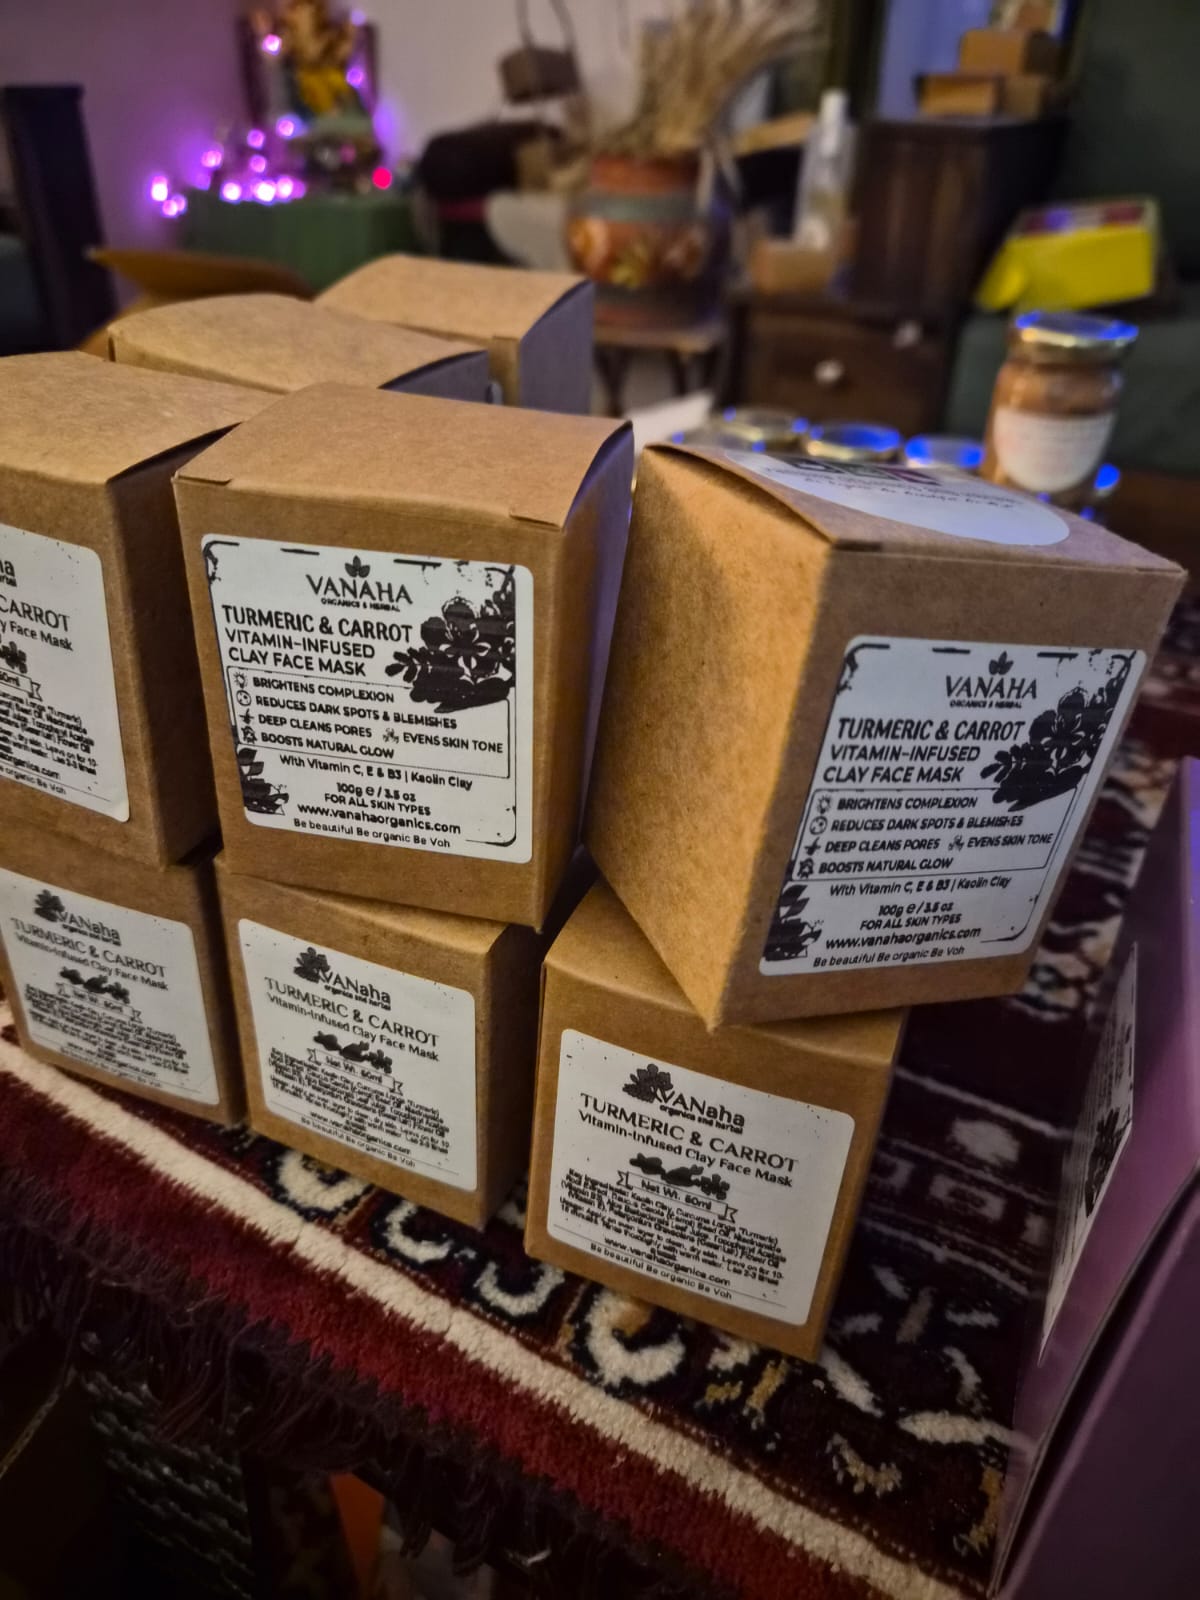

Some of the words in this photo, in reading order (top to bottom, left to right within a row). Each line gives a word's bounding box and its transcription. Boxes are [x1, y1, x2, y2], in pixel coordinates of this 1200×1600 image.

[305, 574, 413, 605] VANAHA
[9, 620, 37, 639] Face
[40, 630, 73, 651] Mask
[221, 604, 314, 633] TURMERIC
[319, 616, 334, 635] &
[338, 618, 413, 643] CARROT
[225, 627, 375, 659] VITAMIN-INFUSED
[228, 646, 268, 665] CLAY
[273, 652, 314, 671] FACE
[318, 657, 366, 677] MASK
[253, 677, 315, 694] BRIGHTENS
[318, 685, 394, 703] COMPLEXION
[946, 675, 1037, 700] VANAHA
[255, 695, 307, 712] REDUCES
[309, 702, 341, 715] DARK
[343, 706, 380, 720] SPOTS
[382, 711, 390, 722] &
[393, 712, 457, 729] BLEMISHES
[258, 714, 287, 726] DEEP
[290, 718, 332, 733] CLEANS
[334, 724, 372, 738] PORES
[838, 717, 934, 741] TURMERIC
[935, 720, 949, 741] &
[954, 720, 1026, 741] CARROT
[261, 732, 304, 747] BOOSTS
[306, 738, 358, 754] NATURAL
[359, 745, 394, 759] GLOW
[403, 732, 441, 746] EVENS
[442, 737, 469, 750] SKIN
[472, 740, 503, 753] TONE
[831, 744, 981, 762] VITAMIN-INFUSED
[279, 754, 305, 767] With
[307, 758, 350, 773] Vitamin
[353, 764, 364, 777] C,
[377, 767, 384, 778] &
[411, 771, 445, 785] Kaolin
[448, 776, 473, 791] Clay
[823, 766, 870, 783] CLAY
[870, 766, 915, 783] FACE
[916, 766, 964, 783] MASK
[324, 793, 346, 805] FOR
[348, 796, 369, 808] ALL
[370, 799, 395, 811] SKIN
[397, 803, 431, 816] TYPES
[837, 798, 903, 810] BRIGHTENS
[905, 797, 978, 810] COMPLEXION
[293, 818, 307, 828] Be
[309, 820, 354, 835] beautiful
[356, 827, 369, 837] Be
[372, 831, 410, 843] organic
[413, 835, 427, 845] Be
[831, 819, 885, 832] REDUCES
[886, 818, 919, 831] DARK
[920, 817, 956, 830] SPOTS
[956, 817, 965, 829] &
[966, 815, 1024, 829] BLEMISHES
[824, 841, 857, 853] DEEP
[858, 839, 902, 852] CLEANS
[903, 838, 941, 850] PORES
[967, 835, 1002, 848] EVENS
[1001, 835, 1026, 846] SKIN
[1027, 833, 1054, 844] TONE
[818, 861, 865, 874] BOOSTS
[866, 859, 917, 872] NATURAL
[919, 857, 954, 870] GLOW
[830, 884, 856, 896] With
[859, 882, 902, 895] Vitamin
[904, 881, 913, 894] C,
[925, 880, 934, 892] &
[957, 877, 988, 889] Kaolin
[990, 876, 1012, 889] Clay
[859, 919, 883, 930] FOR
[882, 917, 903, 929] ALL
[905, 916, 930, 927] SKIN
[932, 913, 962, 925] TYPES
[10, 917, 86, 954] TURMERIC
[102, 950, 164, 978] CARROT
[813, 957, 827, 967] Be
[829, 953, 876, 966] beautiful
[877, 952, 891, 962] Be
[892, 950, 929, 962] organic
[930, 947, 944, 958] Be
[264, 976, 348, 1018] TURMERIC
[353, 1009, 363, 1023] &
[368, 1015, 438, 1047] CARROT
[352, 1025, 377, 1043] Clay
[379, 1034, 405, 1050] Face
[409, 1044, 439, 1062] Mask
[580, 1093, 685, 1140] TURMERIC
[689, 1131, 703, 1147] &
[709, 1138, 798, 1173] CARROT
[579, 1110, 682, 1155] Vitamin-Infused
[685, 1148, 716, 1168] Clay
[719, 1158, 751, 1175] Face
[755, 1168, 792, 1187] Mask
